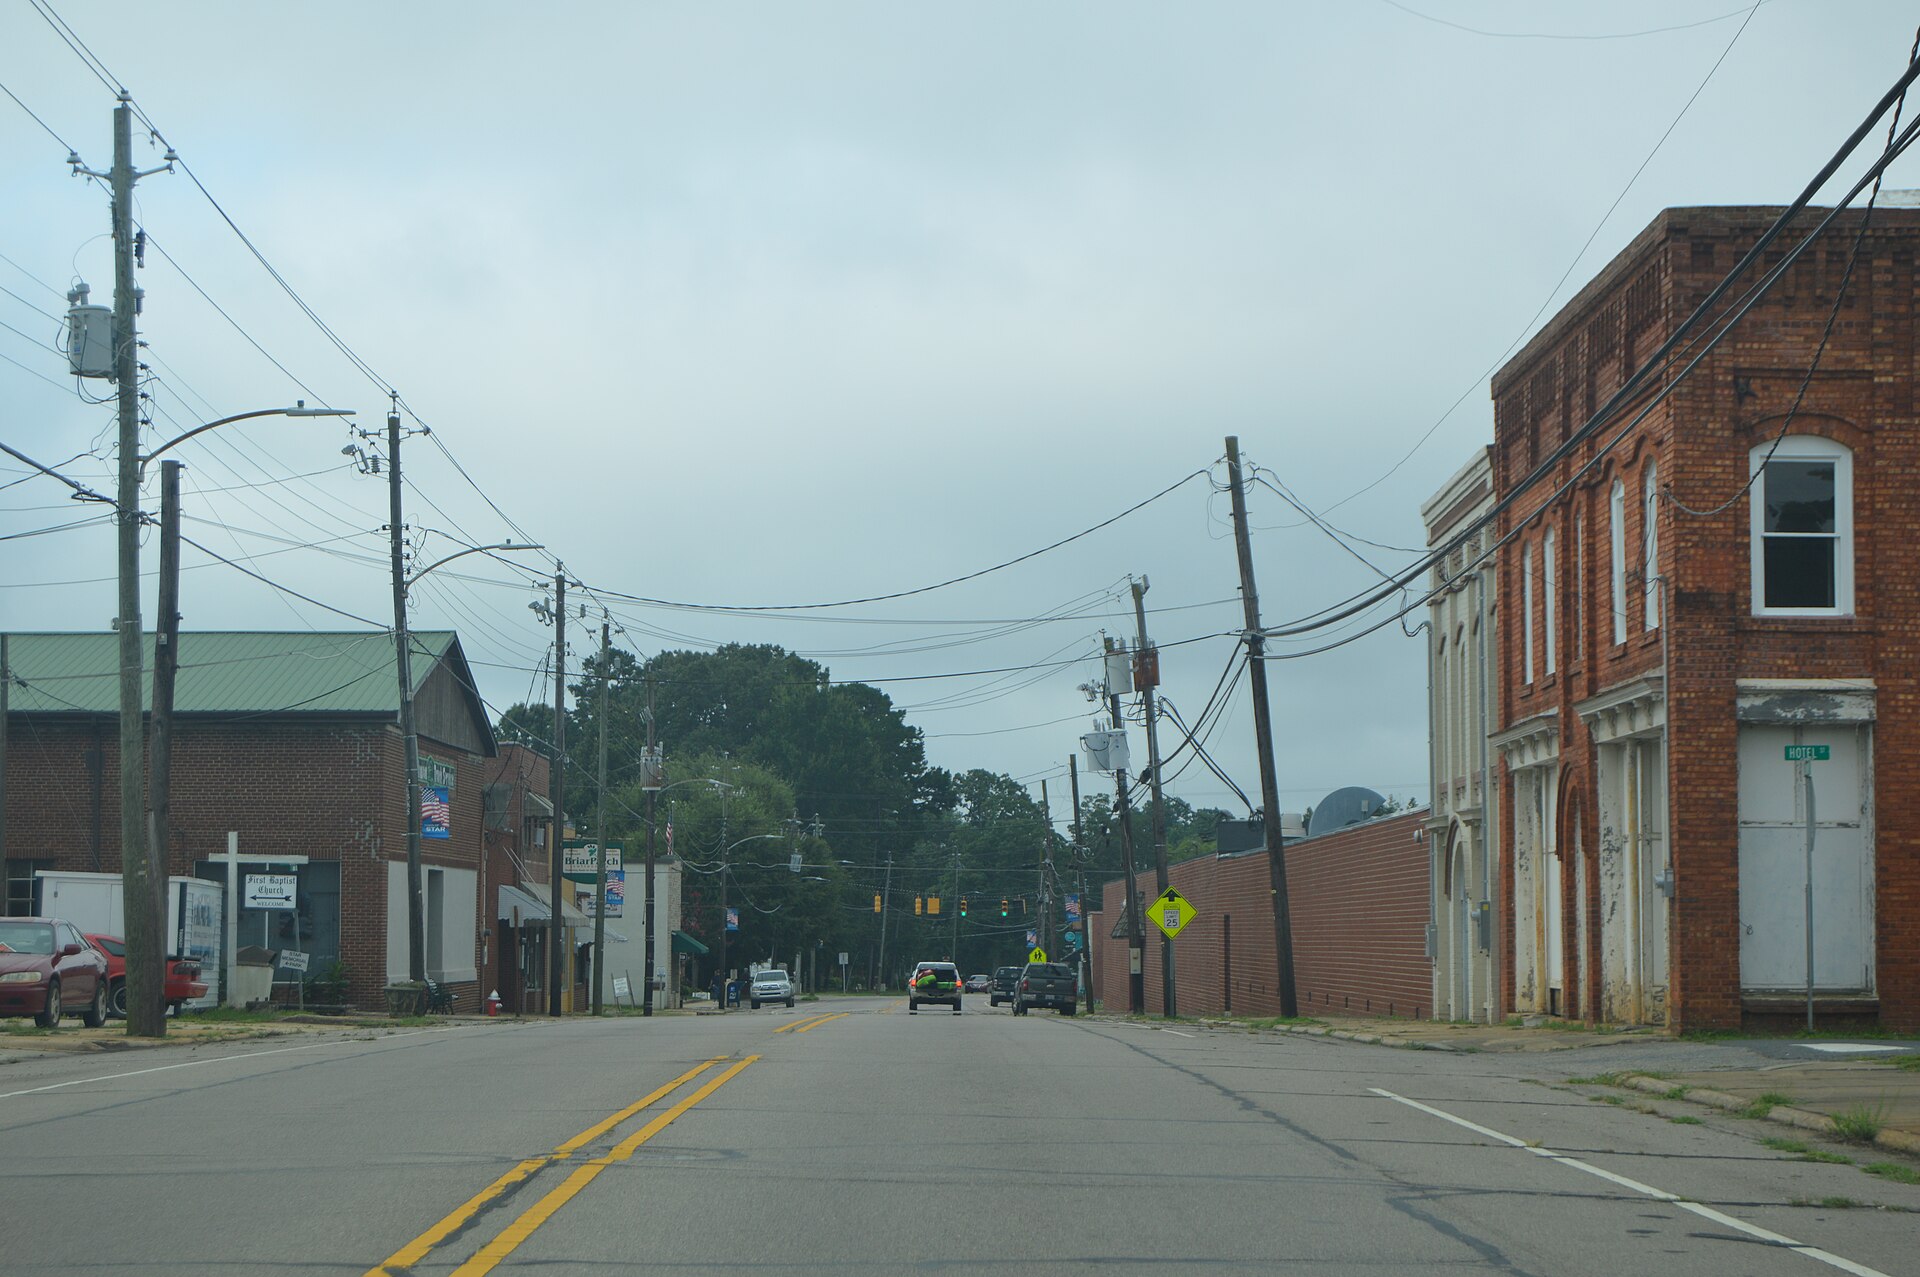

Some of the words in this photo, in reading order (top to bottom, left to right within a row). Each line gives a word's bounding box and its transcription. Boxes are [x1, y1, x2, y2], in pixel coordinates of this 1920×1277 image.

[1789, 747, 1817, 759] HOTEL
[565, 857, 619, 866] BriarPch
[247, 875, 266, 884] First
[269, 875, 296, 885] Baptist
[257, 885, 284, 896] Church
[1166, 919, 1178, 927] 25
